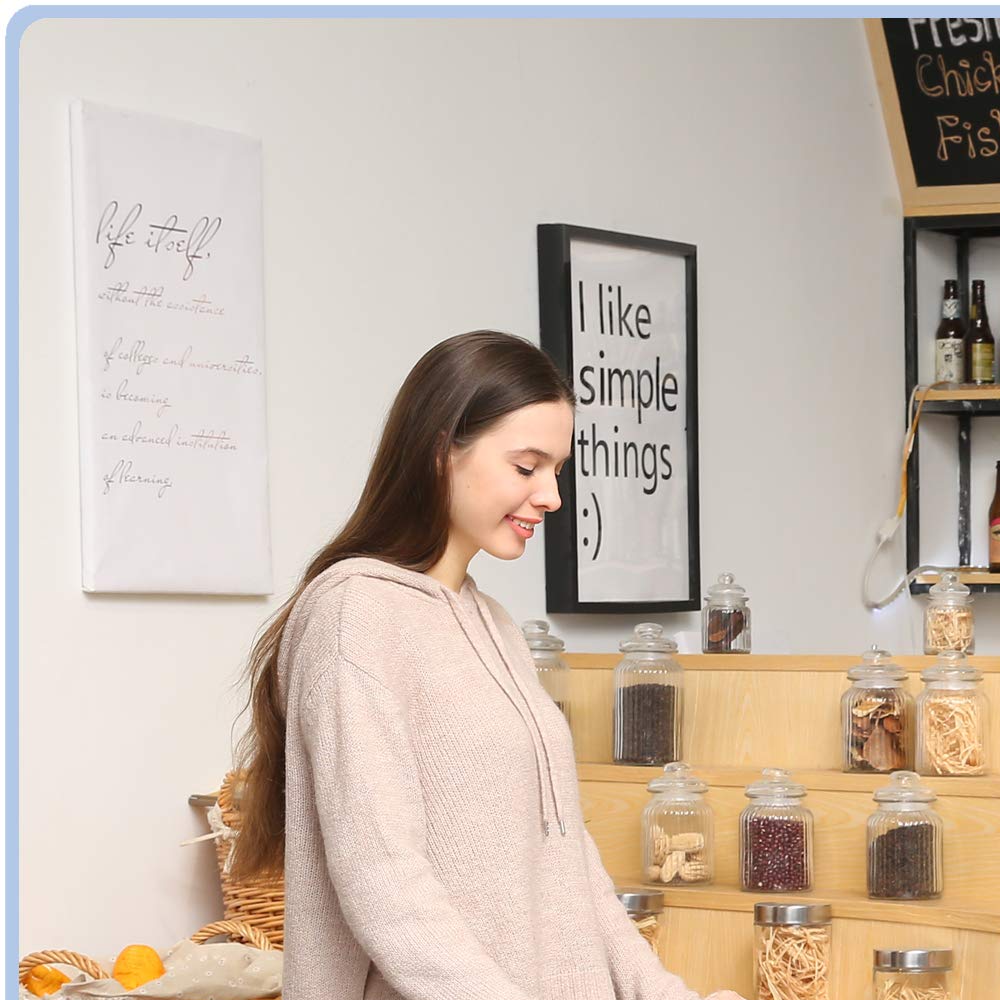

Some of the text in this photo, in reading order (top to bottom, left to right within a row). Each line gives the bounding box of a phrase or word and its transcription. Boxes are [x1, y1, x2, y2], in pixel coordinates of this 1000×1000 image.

[96, 200, 142, 269] life
[578, 280, 652, 340] I like
[103, 336, 123, 372] of
[116, 378, 172, 418] becoming
[579, 350, 679, 424] simple
[121, 420, 178, 448] advanced
[577, 423, 673, 495] things
[103, 459, 124, 495] of
